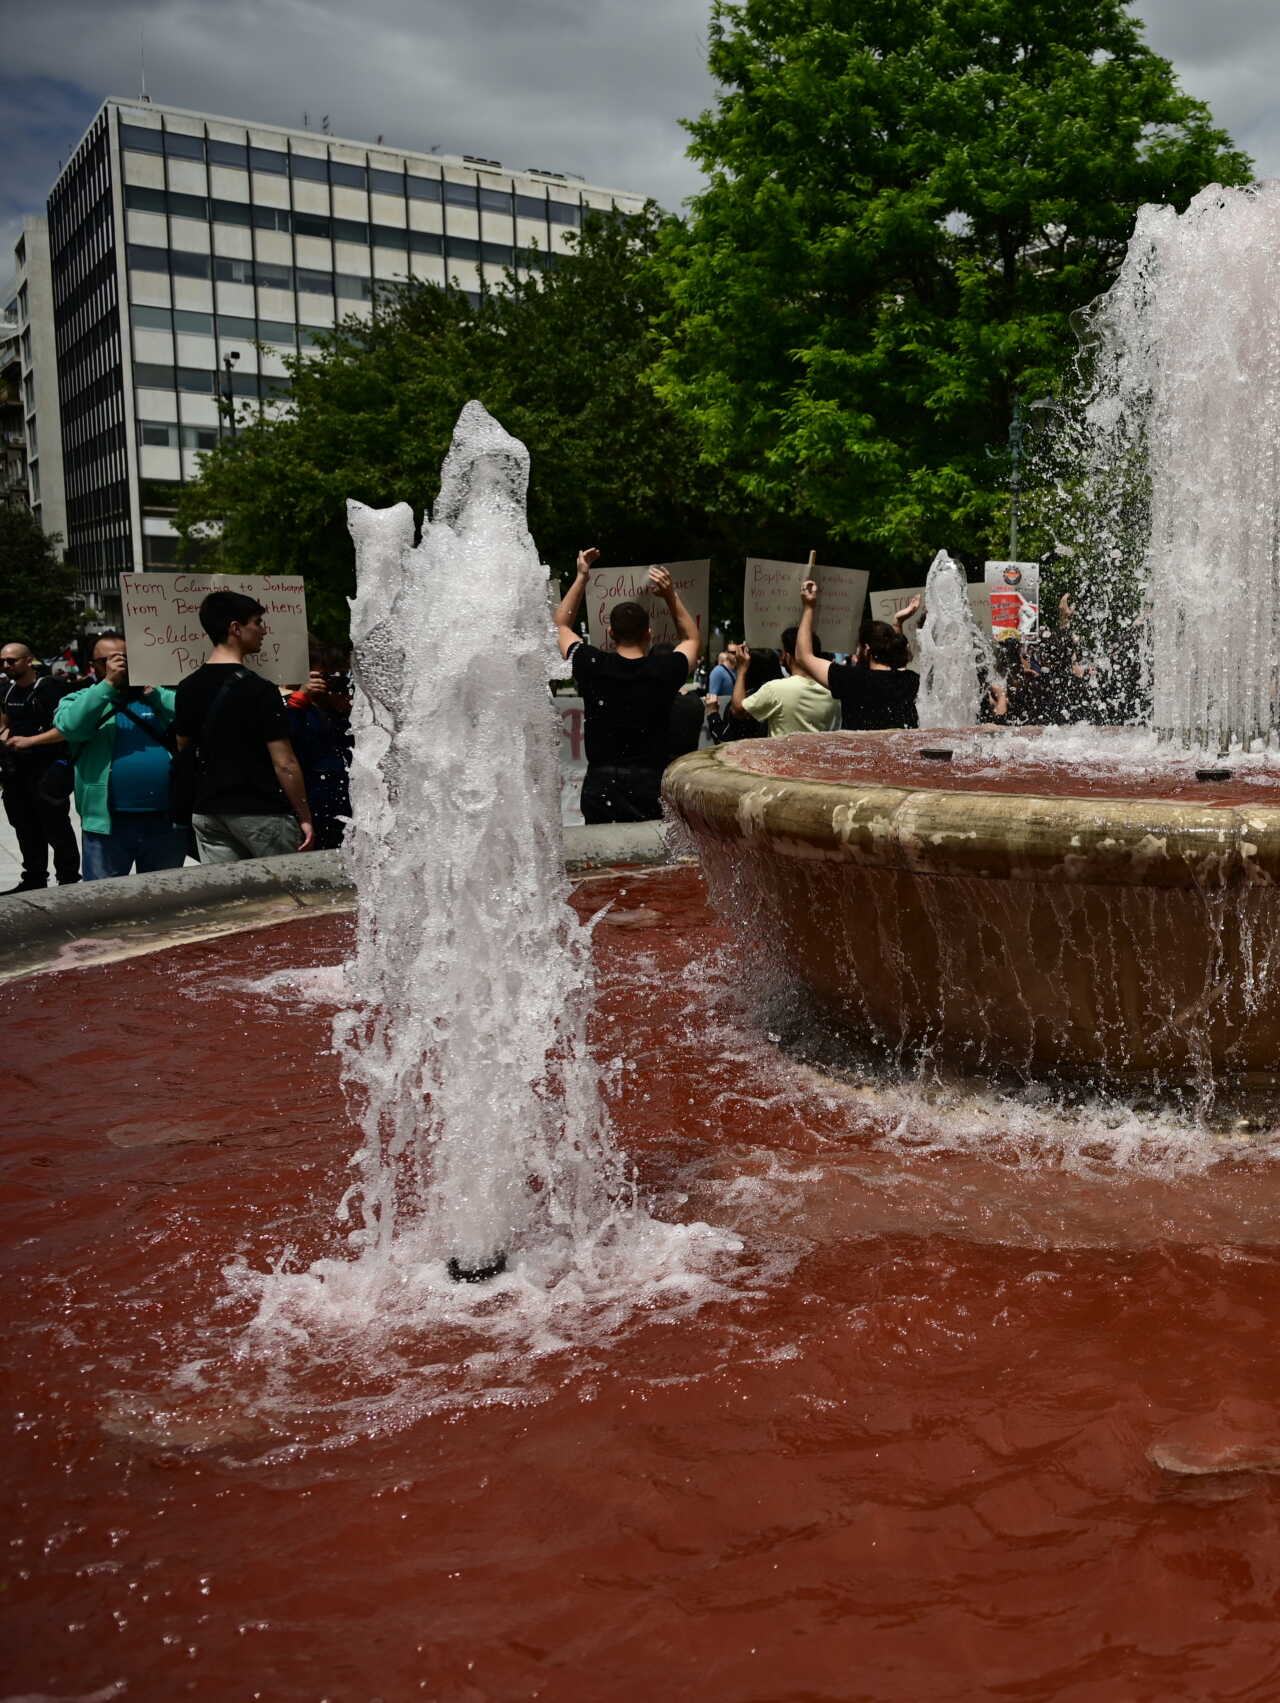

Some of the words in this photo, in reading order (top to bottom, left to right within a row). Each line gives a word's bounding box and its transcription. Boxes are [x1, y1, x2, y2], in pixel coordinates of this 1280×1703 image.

[122, 574, 167, 600] From
[174, 575, 230, 593] Columbia
[239, 580, 253, 592] to
